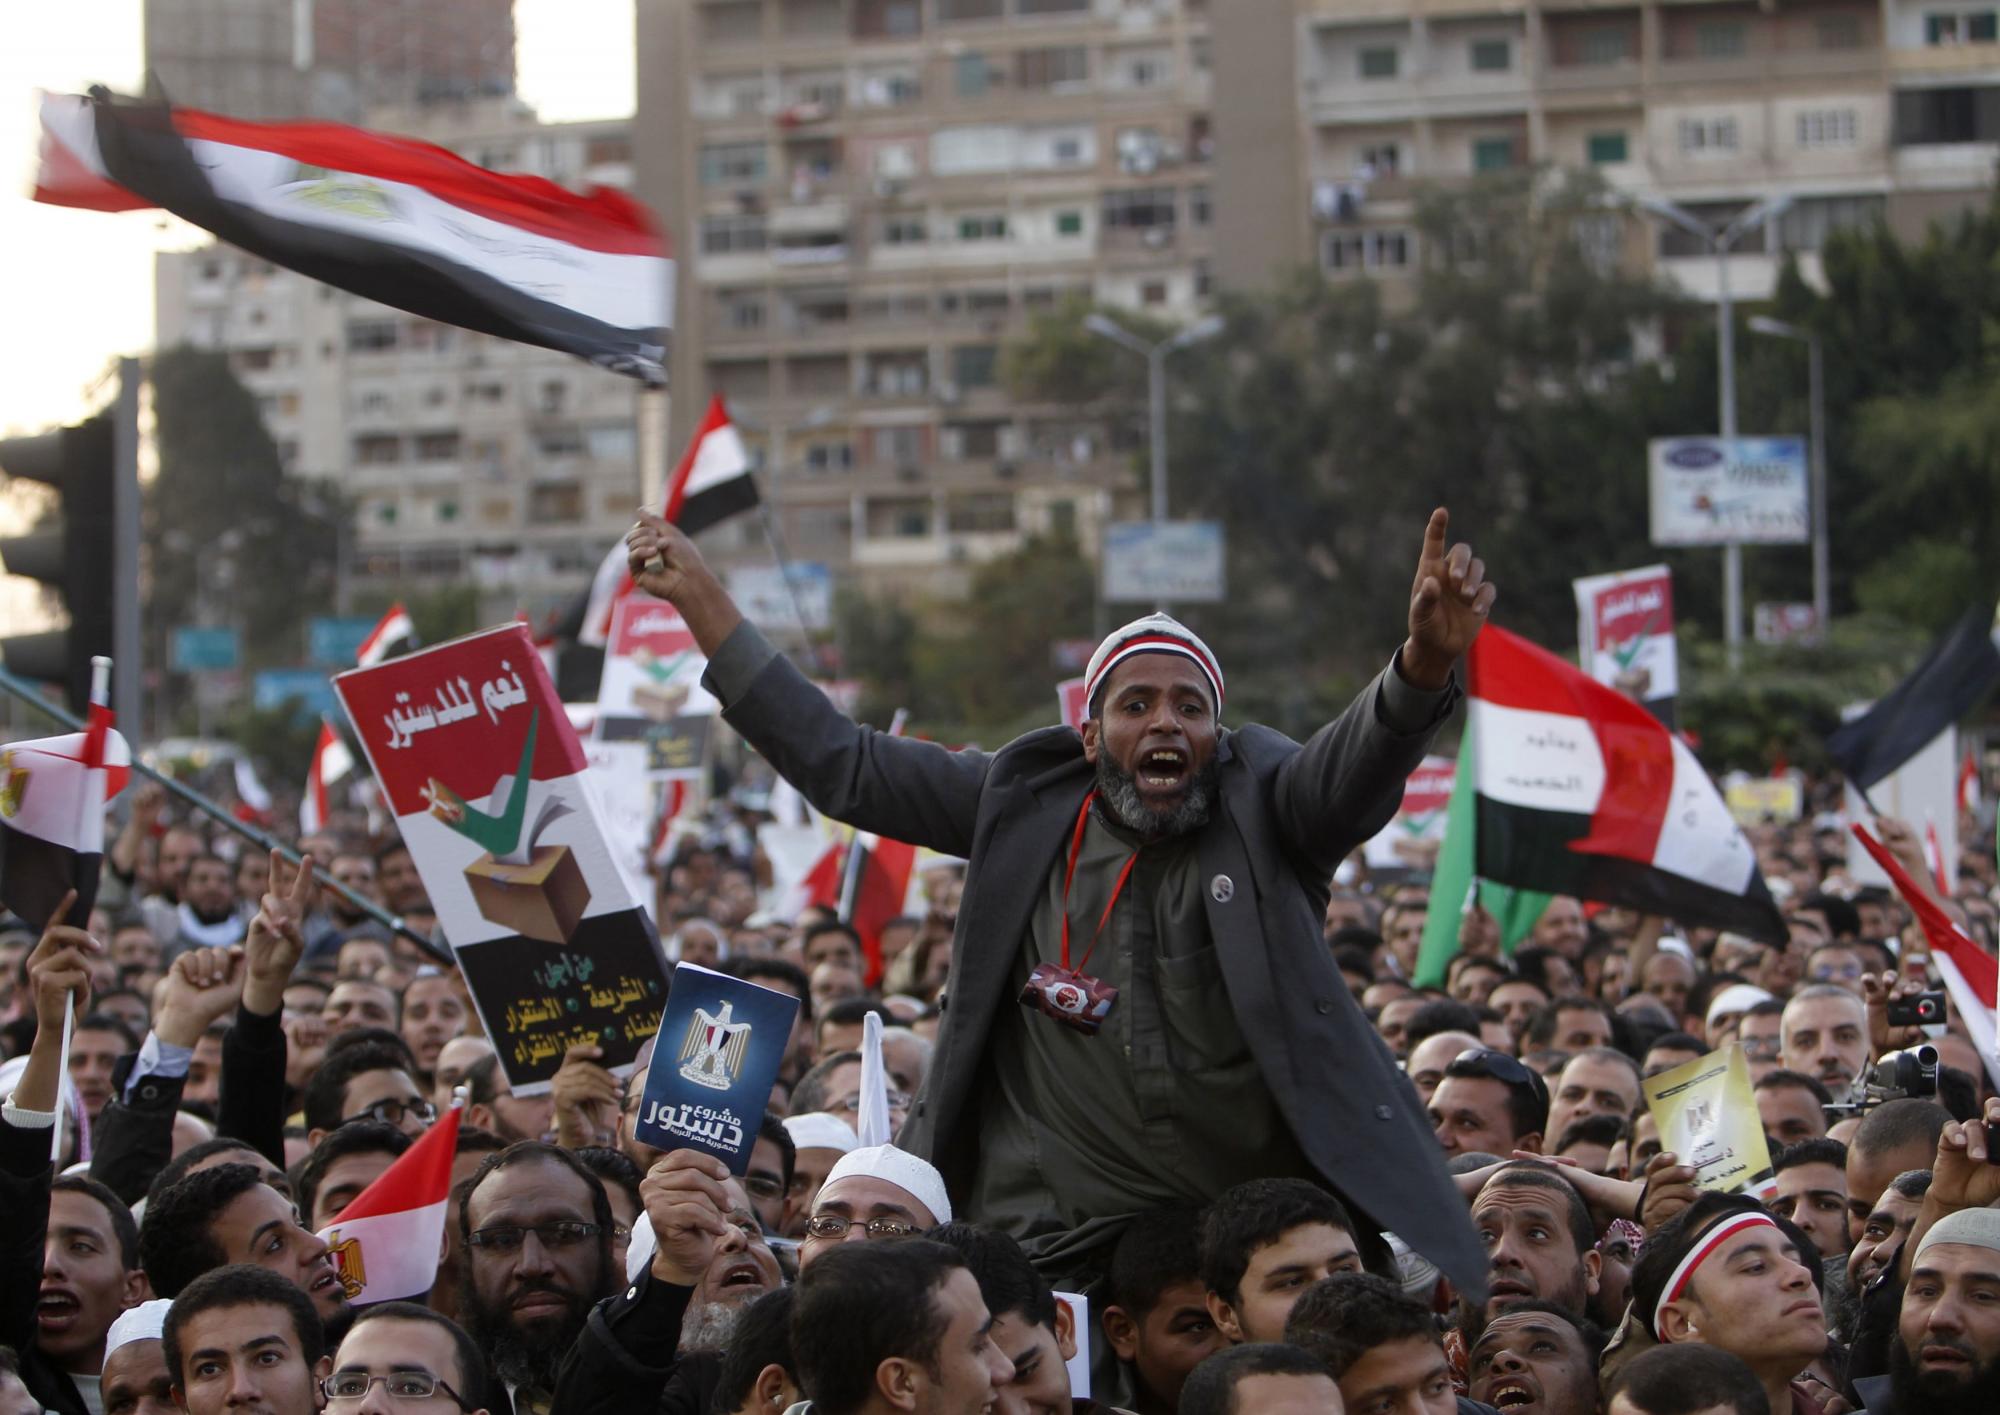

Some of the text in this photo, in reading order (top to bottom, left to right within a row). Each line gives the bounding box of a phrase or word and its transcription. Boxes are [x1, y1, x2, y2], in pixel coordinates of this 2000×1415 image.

[383, 659, 528, 750] نعم للدستور
[582, 976, 647, 1014] الشريعة
[643, 1100, 744, 1147] دستور
[693, 1105, 741, 1126] مشروع
[690, 1133, 706, 1143] مصر
